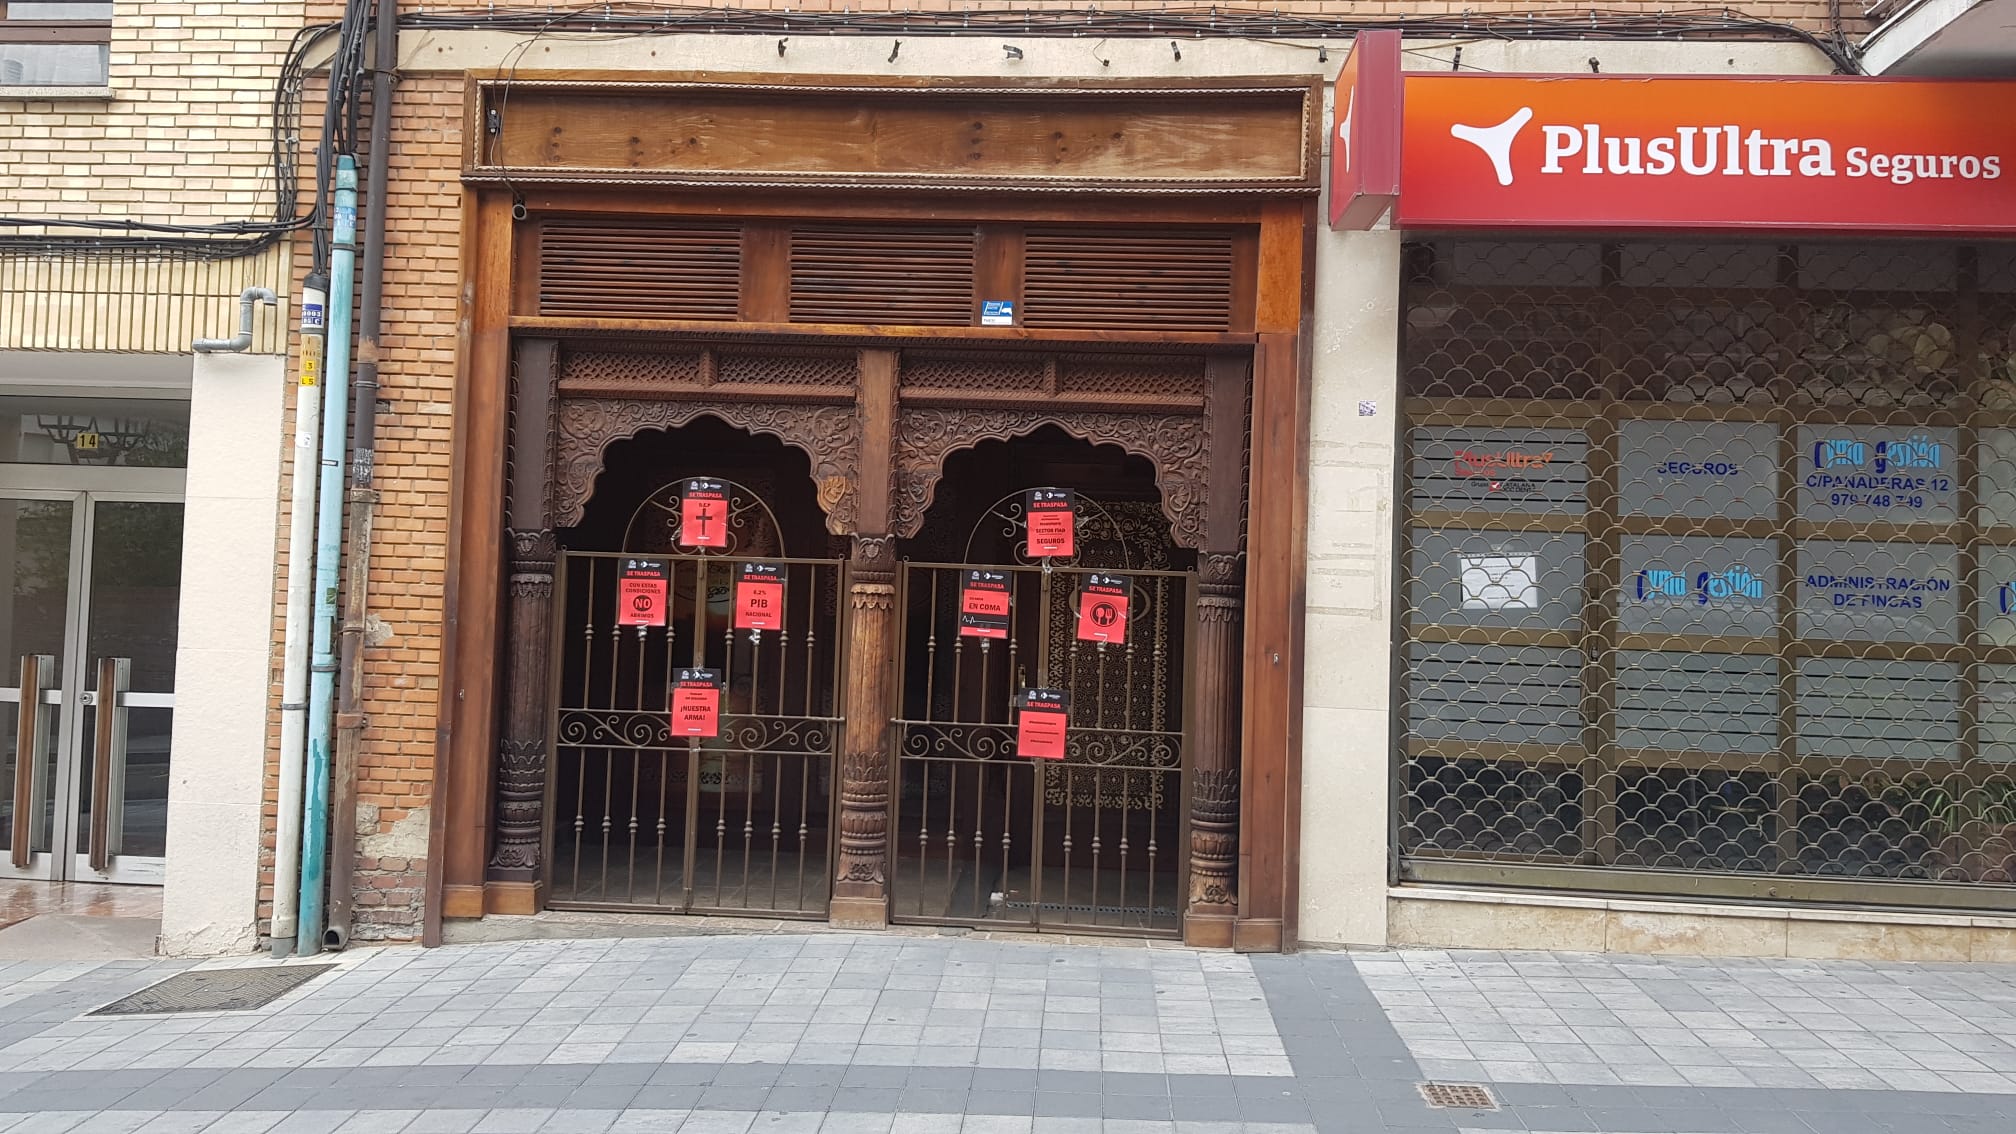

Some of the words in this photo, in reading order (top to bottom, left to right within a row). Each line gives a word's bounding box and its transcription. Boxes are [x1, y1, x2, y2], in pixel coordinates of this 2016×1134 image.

[1541, 124, 1836, 176] PlusUltra
[1846, 147, 2001, 185] Seguros
[80, 434, 96, 447] 14
[1657, 462, 1738, 475] SEGUROS
[635, 598, 651, 609] NO
[751, 598, 768, 608] PIB
[1833, 594, 1857, 606] DE
[980, 603, 1001, 611] COMA
